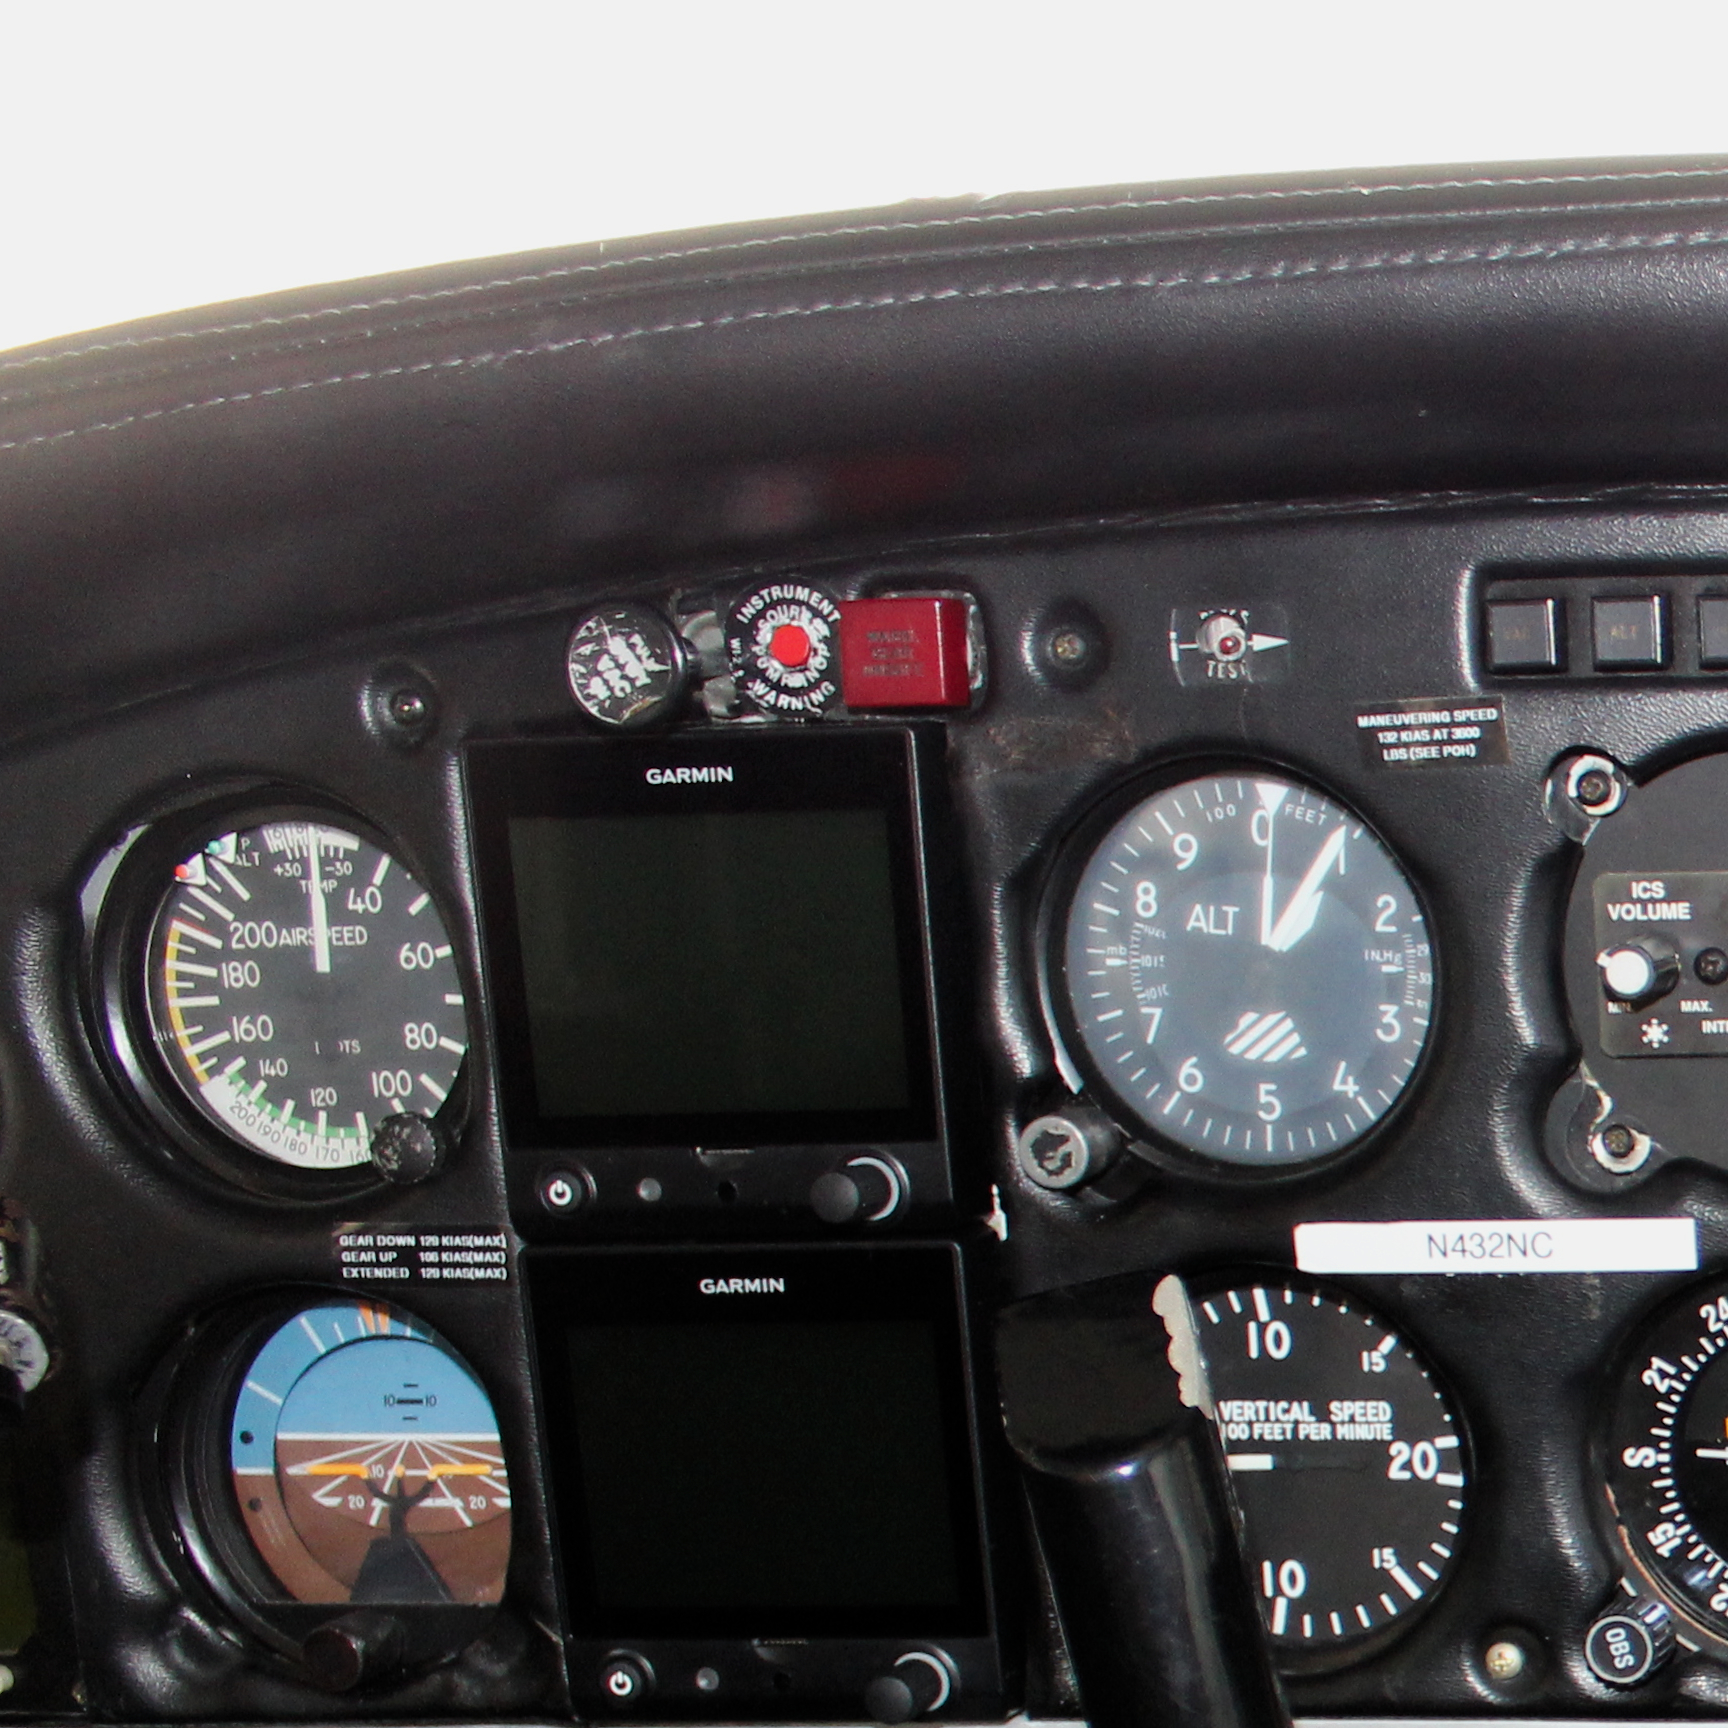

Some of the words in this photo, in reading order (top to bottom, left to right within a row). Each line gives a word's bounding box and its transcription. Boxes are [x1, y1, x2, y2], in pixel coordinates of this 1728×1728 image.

[736, 584, 841, 624] INSTRUMENT
[752, 681, 836, 712] WARNING
[1357, 710, 1450, 728] MANEUVERING
[1453, 707, 1498, 722] SPEED
[1377, 731, 1398, 744] 132
[1400, 730, 1430, 742] KIAS
[1433, 728, 1450, 740] AT
[1383, 747, 1407, 761] LBS
[1410, 746, 1441, 760] (SEE
[645, 766, 733, 784] GARMIN
[1284, 804, 1327, 824] FEET
[1631, 880, 1665, 899] ICS
[1186, 904, 1240, 935] ALT
[1607, 901, 1691, 921] VOLUME
[229, 921, 277, 949] 200
[399, 941, 434, 970] 60
[221, 961, 260, 989] 180
[403, 1022, 437, 1050] 80
[1426, 1232, 1553, 1261] N432NC
[342, 1267, 410, 1280] EXTENDED
[700, 1276, 785, 1294] GARMIN
[1220, 1403, 1317, 1424] VERTICAL
[1330, 1402, 1392, 1424] SPEED
[1252, 1424, 1292, 1441] FEET
[1298, 1424, 1329, 1441] PER
[1332, 1424, 1392, 1441] MINUTE
[1388, 1442, 1438, 1481] 20
[1604, 1626, 1634, 1671] OBS
